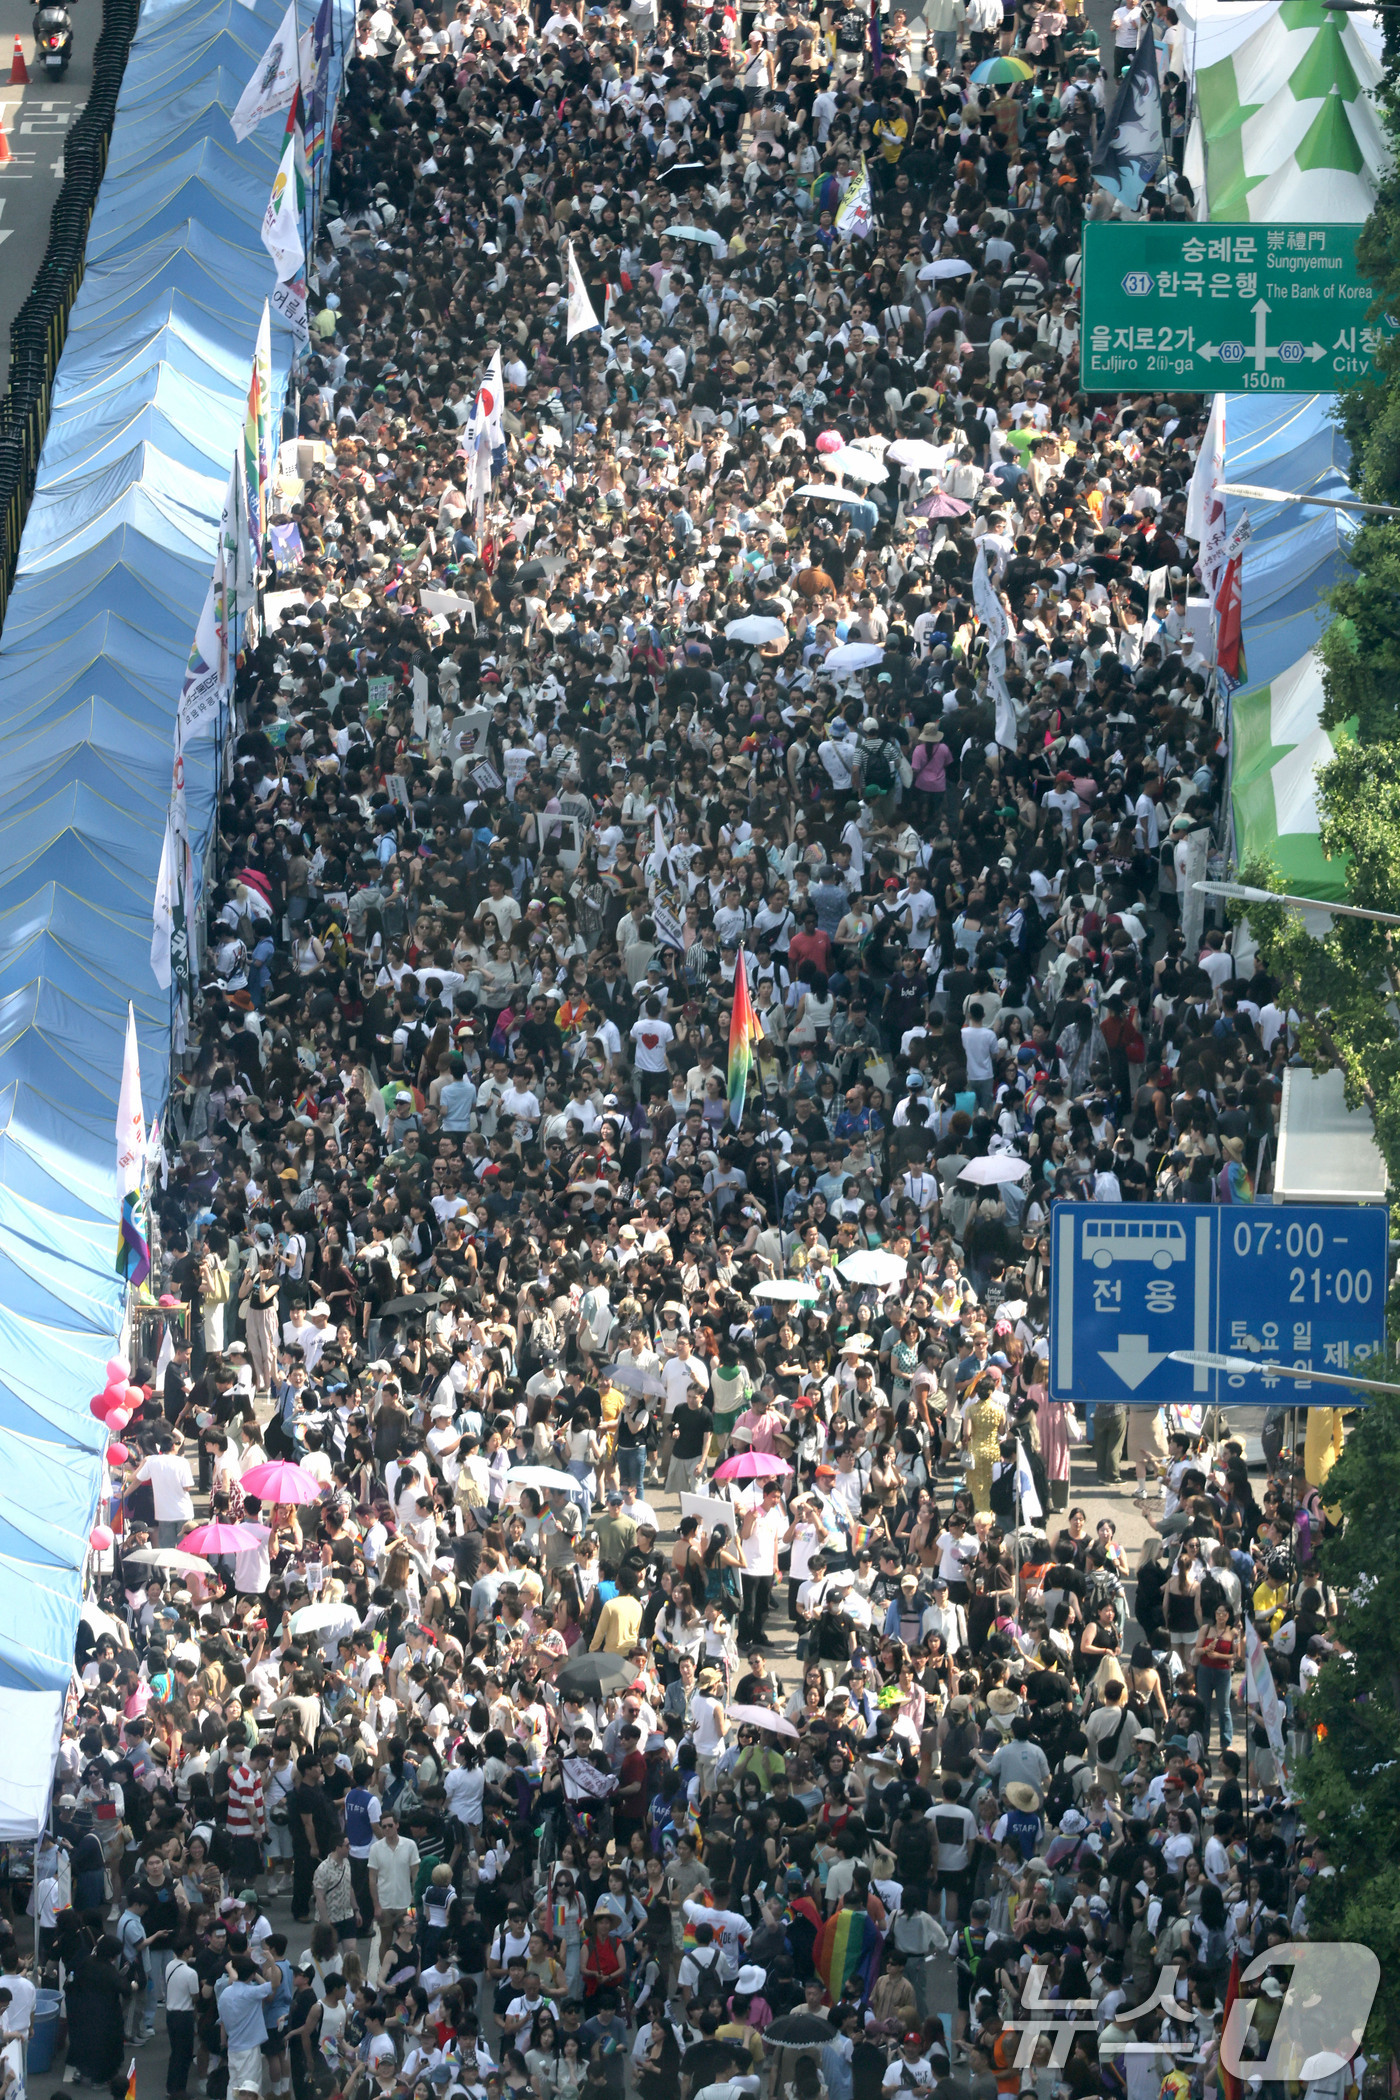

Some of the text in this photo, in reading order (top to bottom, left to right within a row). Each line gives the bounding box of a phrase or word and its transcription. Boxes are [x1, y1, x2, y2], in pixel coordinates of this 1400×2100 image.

[1181, 236, 1258, 263] 숭례문
[1266, 231, 1326, 251] 崇禮門
[1266, 253, 1343, 272] Sungnyemun
[1129, 276, 1146, 291] 31
[1156, 271, 1258, 299] 한국은행
[1266, 283, 1373, 300] The Bank of Korea
[1090, 325, 1195, 352] 을지로2가
[1223, 345, 1240, 359] 60
[1283, 345, 1300, 359] 60
[1146, 355, 1194, 374] 2(i)-ga
[1333, 356, 1369, 375] City
[1241, 372, 1285, 389] 150m
[1289, 1267, 1373, 1304] 21:00
